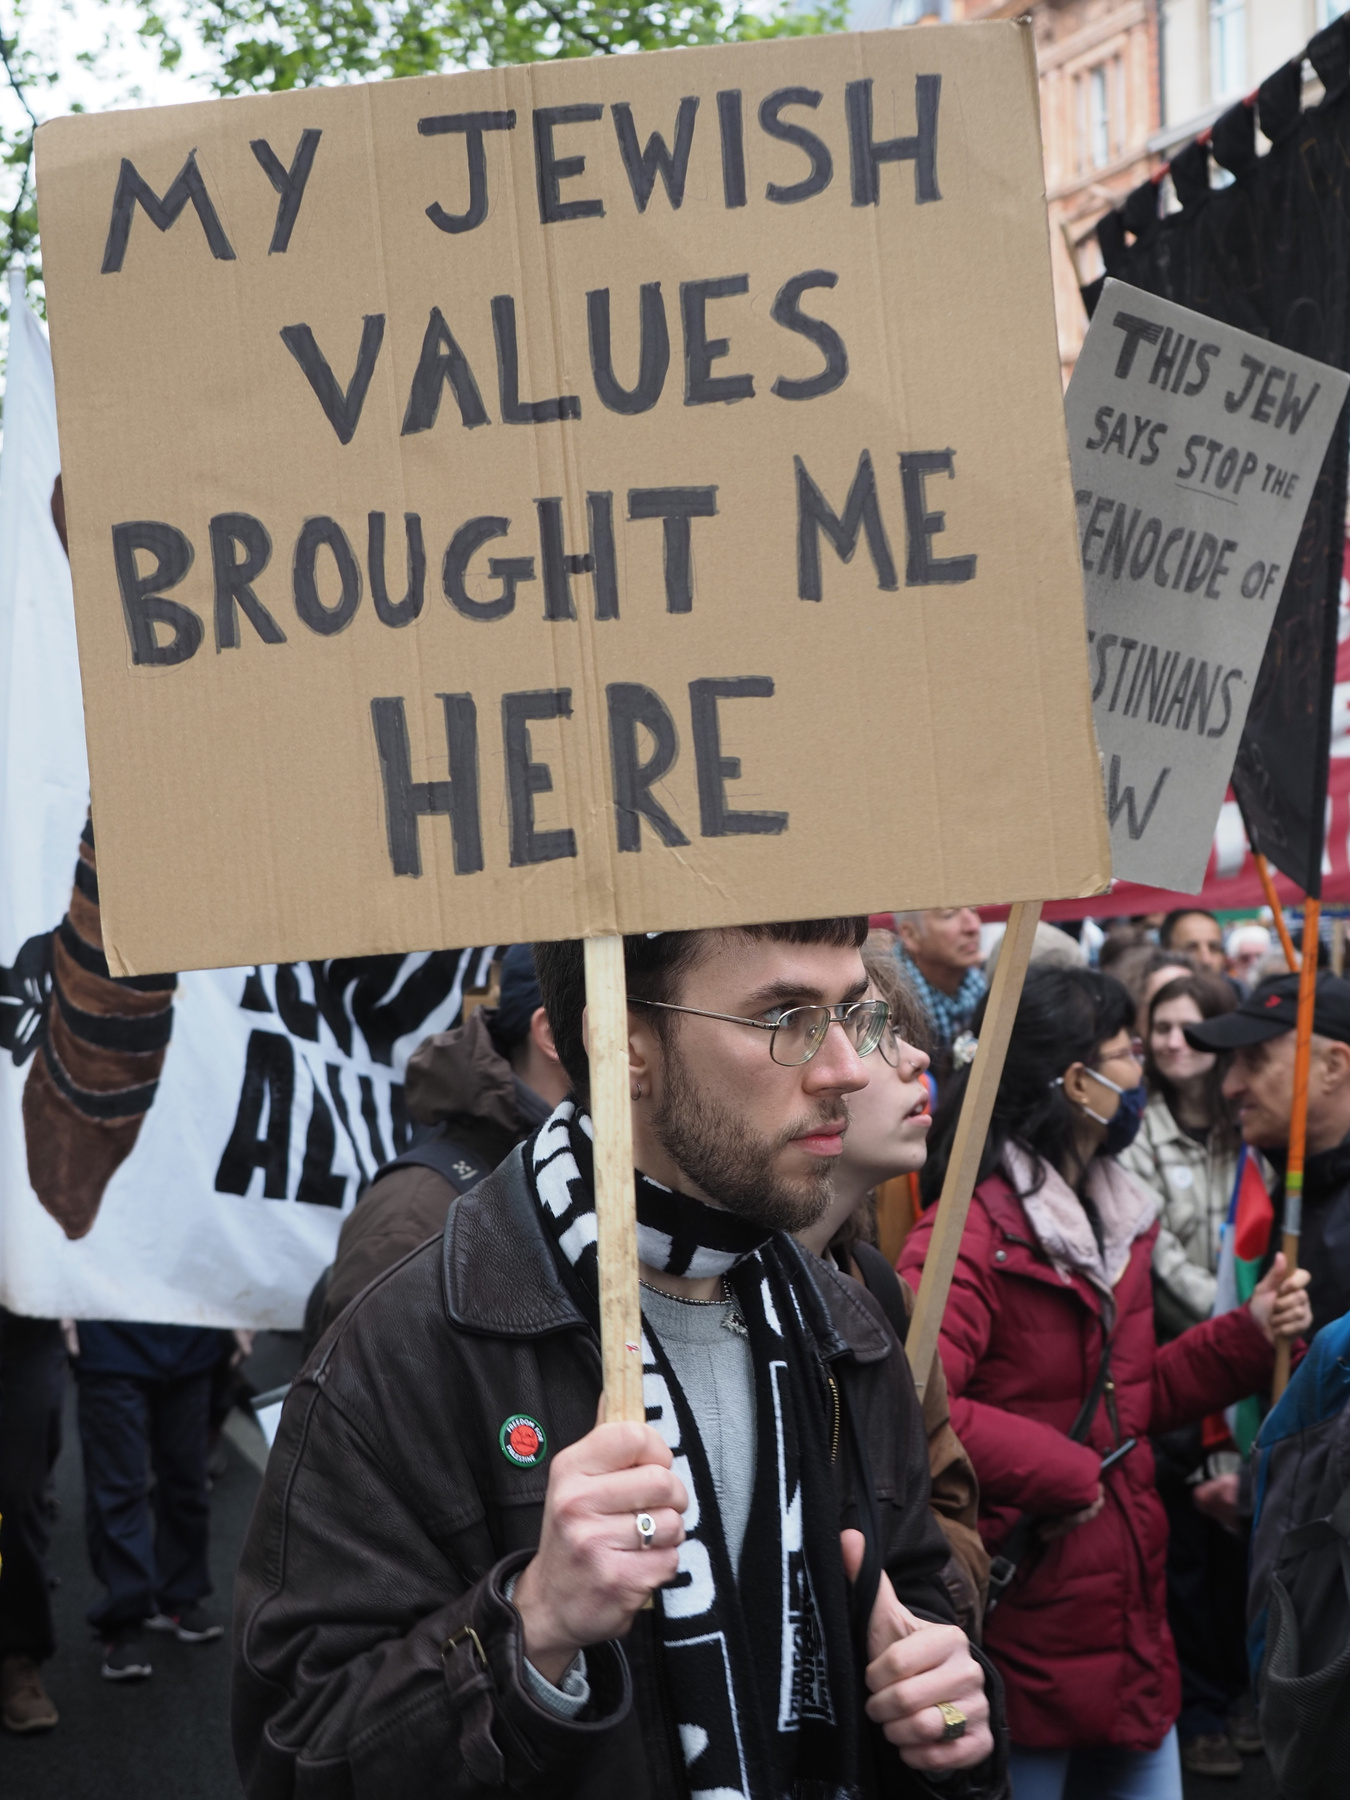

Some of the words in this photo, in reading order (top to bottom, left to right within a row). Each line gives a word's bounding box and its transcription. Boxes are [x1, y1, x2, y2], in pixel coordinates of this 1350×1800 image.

[101, 129, 322, 275] MY
[417, 74, 943, 235] JEWISH
[280, 270, 848, 445] VALUES
[1112, 311, 1221, 397] THIS
[1224, 353, 1322, 436] JEW
[1085, 405, 1168, 467] SAYS
[1175, 434, 1258, 495] STOP
[1261, 463, 1300, 499] THE
[111, 486, 718, 667] BROUGHT
[794, 448, 978, 602] ME
[1240, 560, 1281, 601] OF
[1088, 629, 1244, 739] STINIANS
[371, 676, 789, 880] HERE
